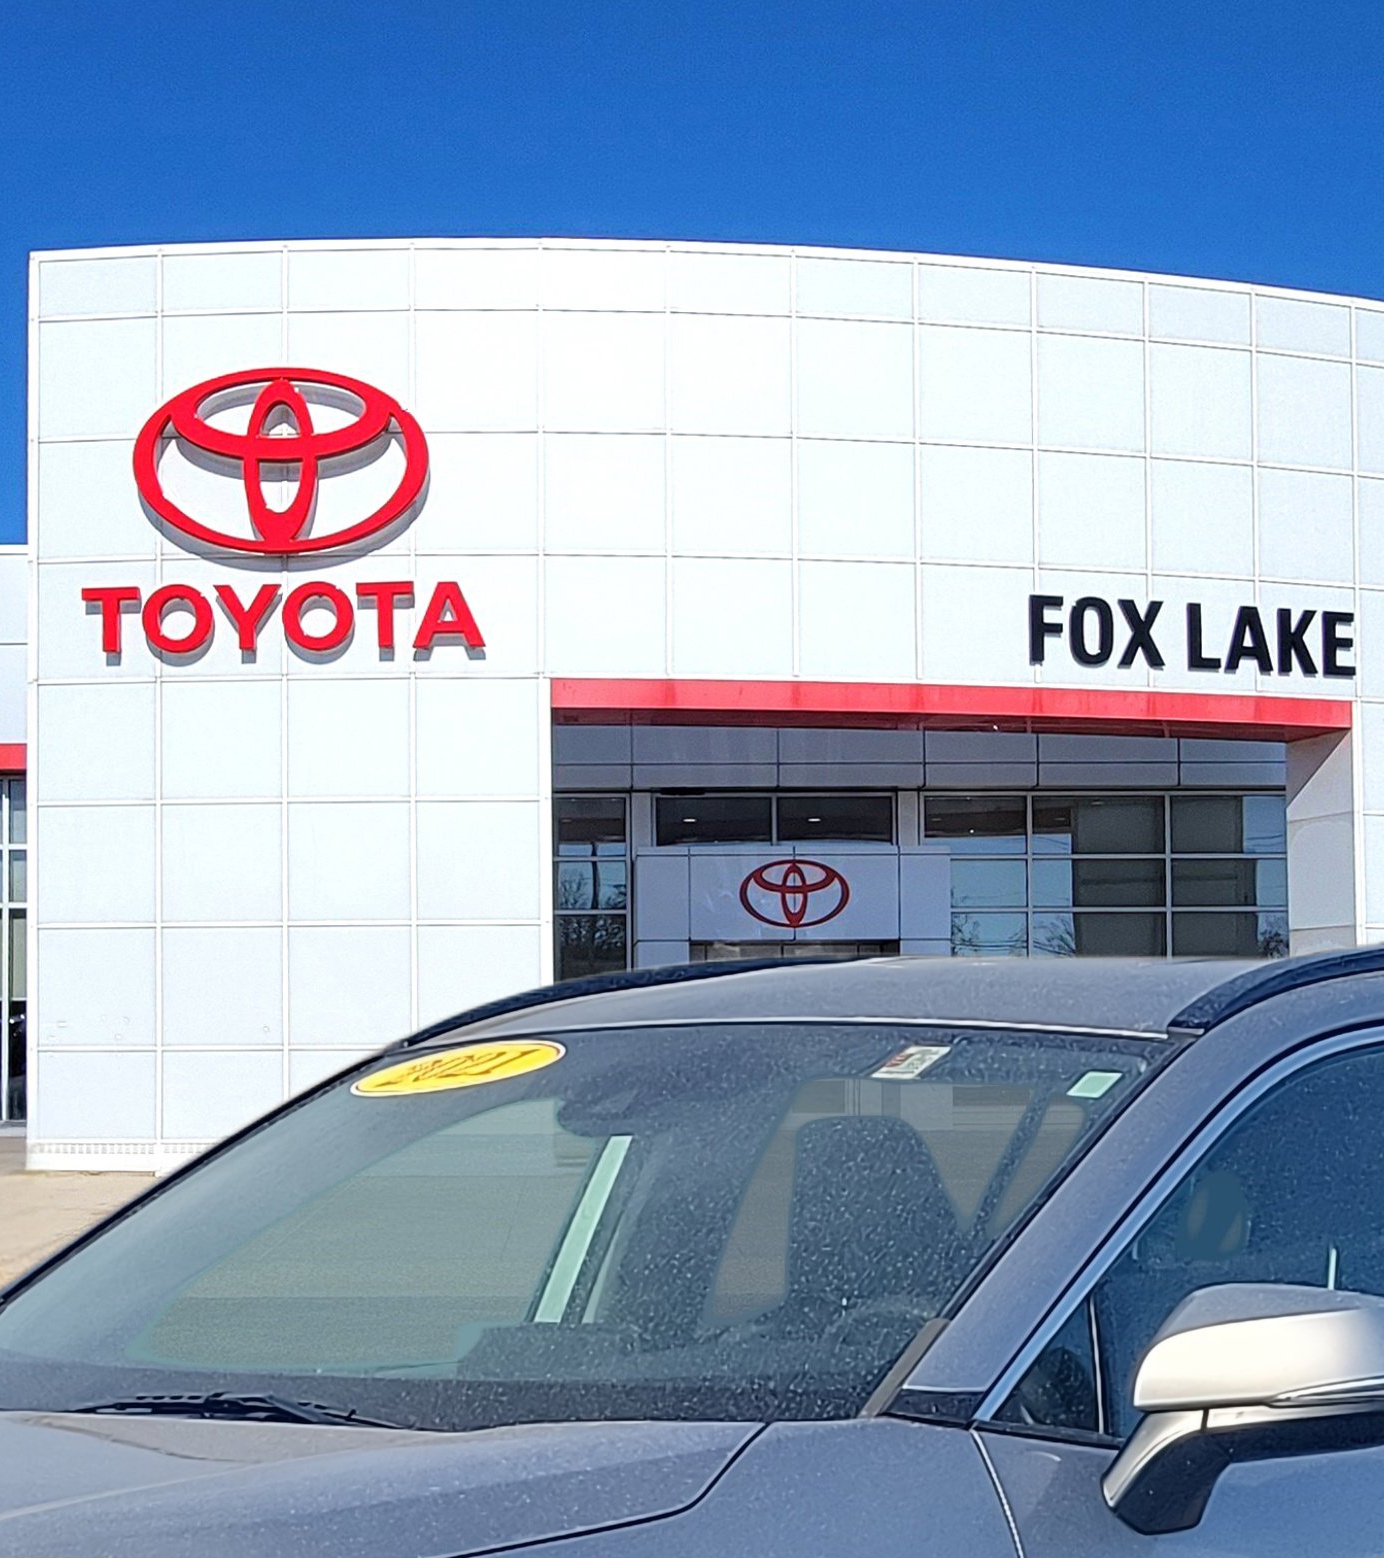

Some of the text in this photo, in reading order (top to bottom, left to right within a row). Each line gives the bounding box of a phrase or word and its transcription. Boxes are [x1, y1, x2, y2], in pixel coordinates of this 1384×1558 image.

[81, 581, 486, 662] TOYOTA
[1028, 594, 1357, 678] FOX LAKE
